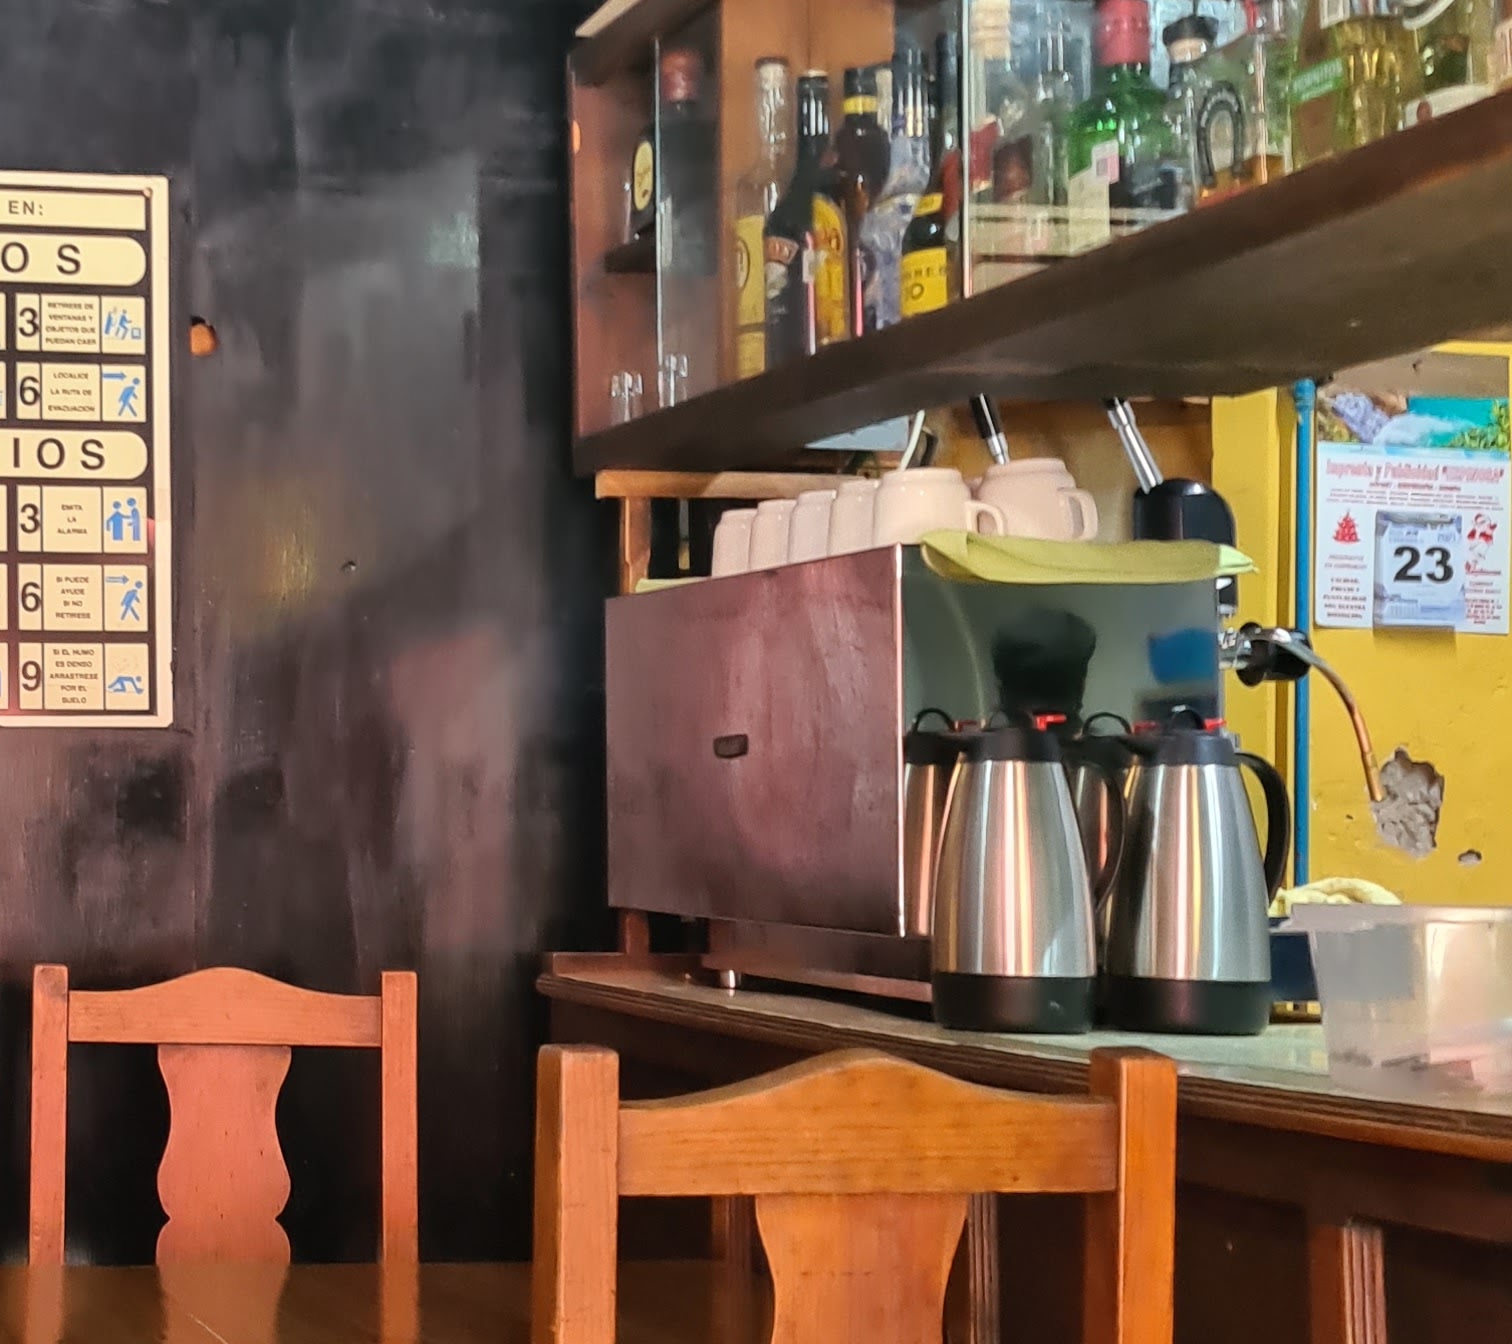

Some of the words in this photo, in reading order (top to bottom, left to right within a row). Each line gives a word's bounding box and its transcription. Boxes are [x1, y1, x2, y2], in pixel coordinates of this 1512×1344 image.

[8, 199, 45, 217] EN:
[18, 307, 40, 337] 3
[19, 375, 41, 407] 6
[20, 503, 40, 534] 3
[1392, 546, 1455, 584] 23
[20, 581, 42, 613] 6
[21, 660, 42, 692] 9
